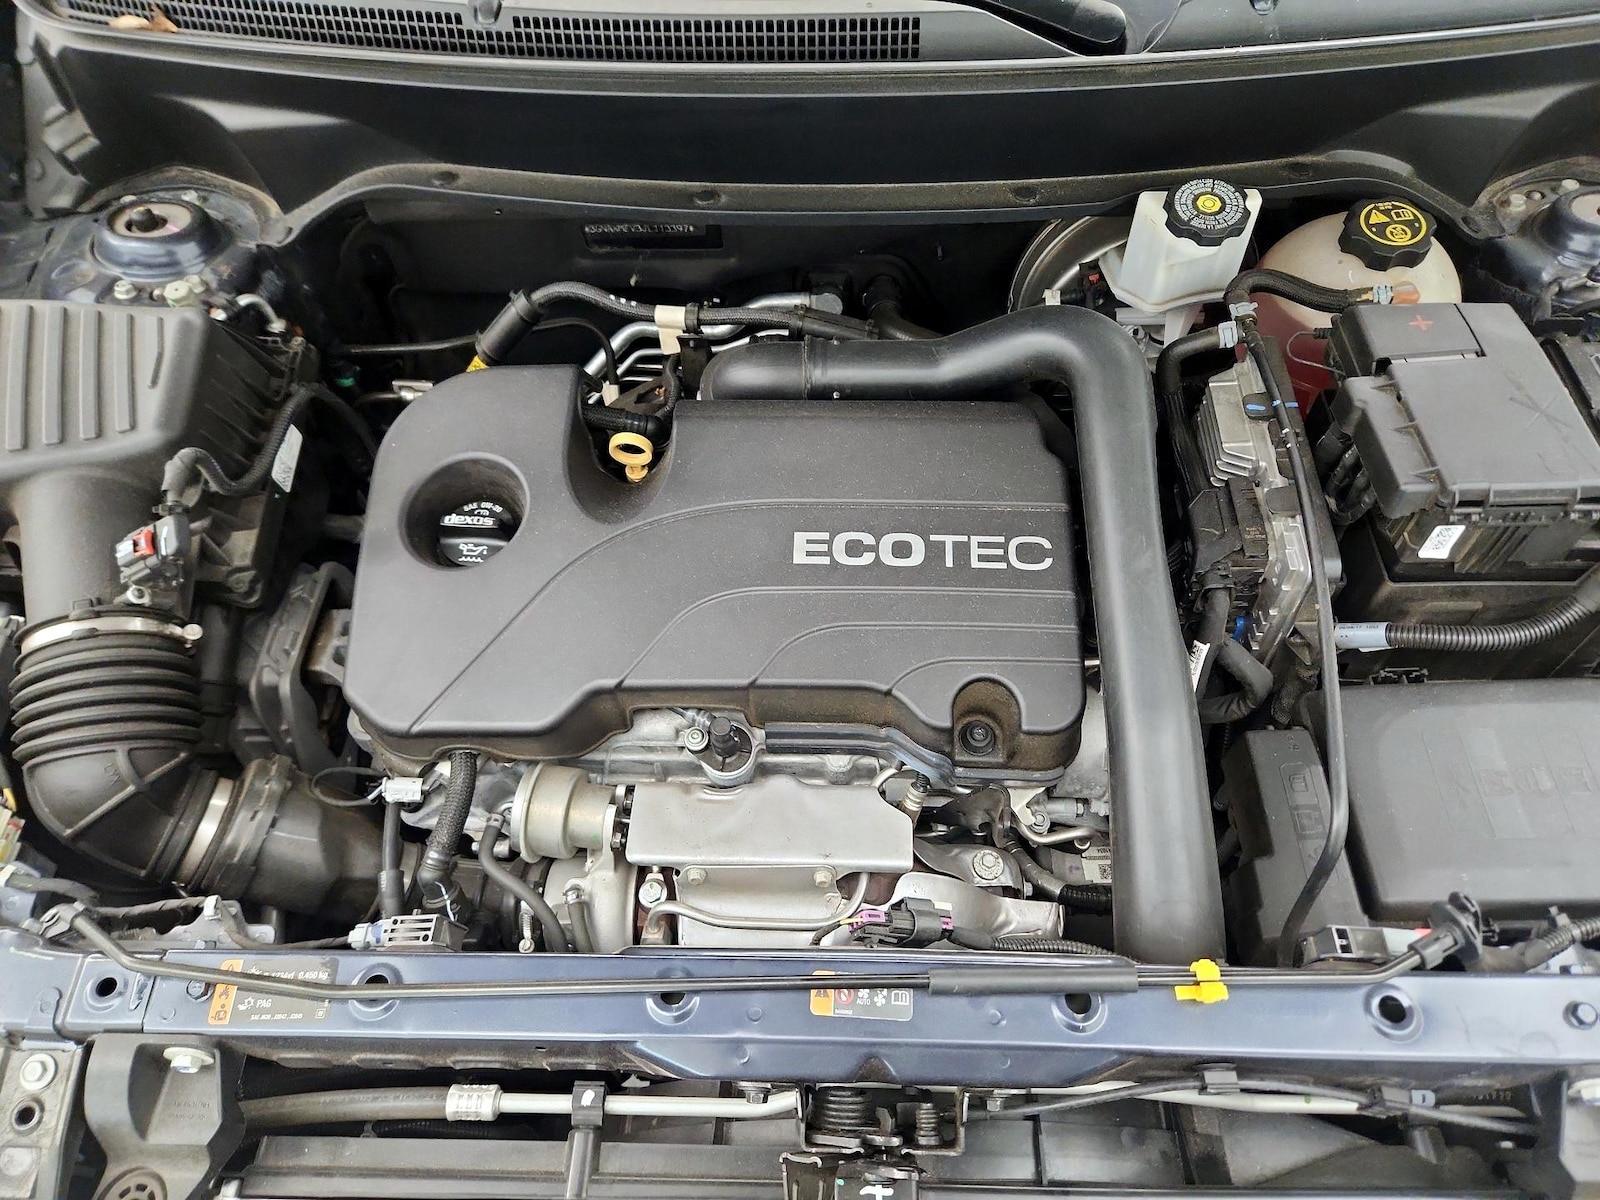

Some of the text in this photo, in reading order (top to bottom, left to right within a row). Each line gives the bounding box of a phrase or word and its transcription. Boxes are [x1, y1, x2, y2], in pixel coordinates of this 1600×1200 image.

[463, 502, 504, 513] SAE 0W-20
[443, 513, 496, 526] dexos
[793, 531, 1054, 571] ECOTEC
[298, 971, 318, 980] 0.450
[319, 971, 329, 981] kg
[256, 999, 272, 1009] PAG
